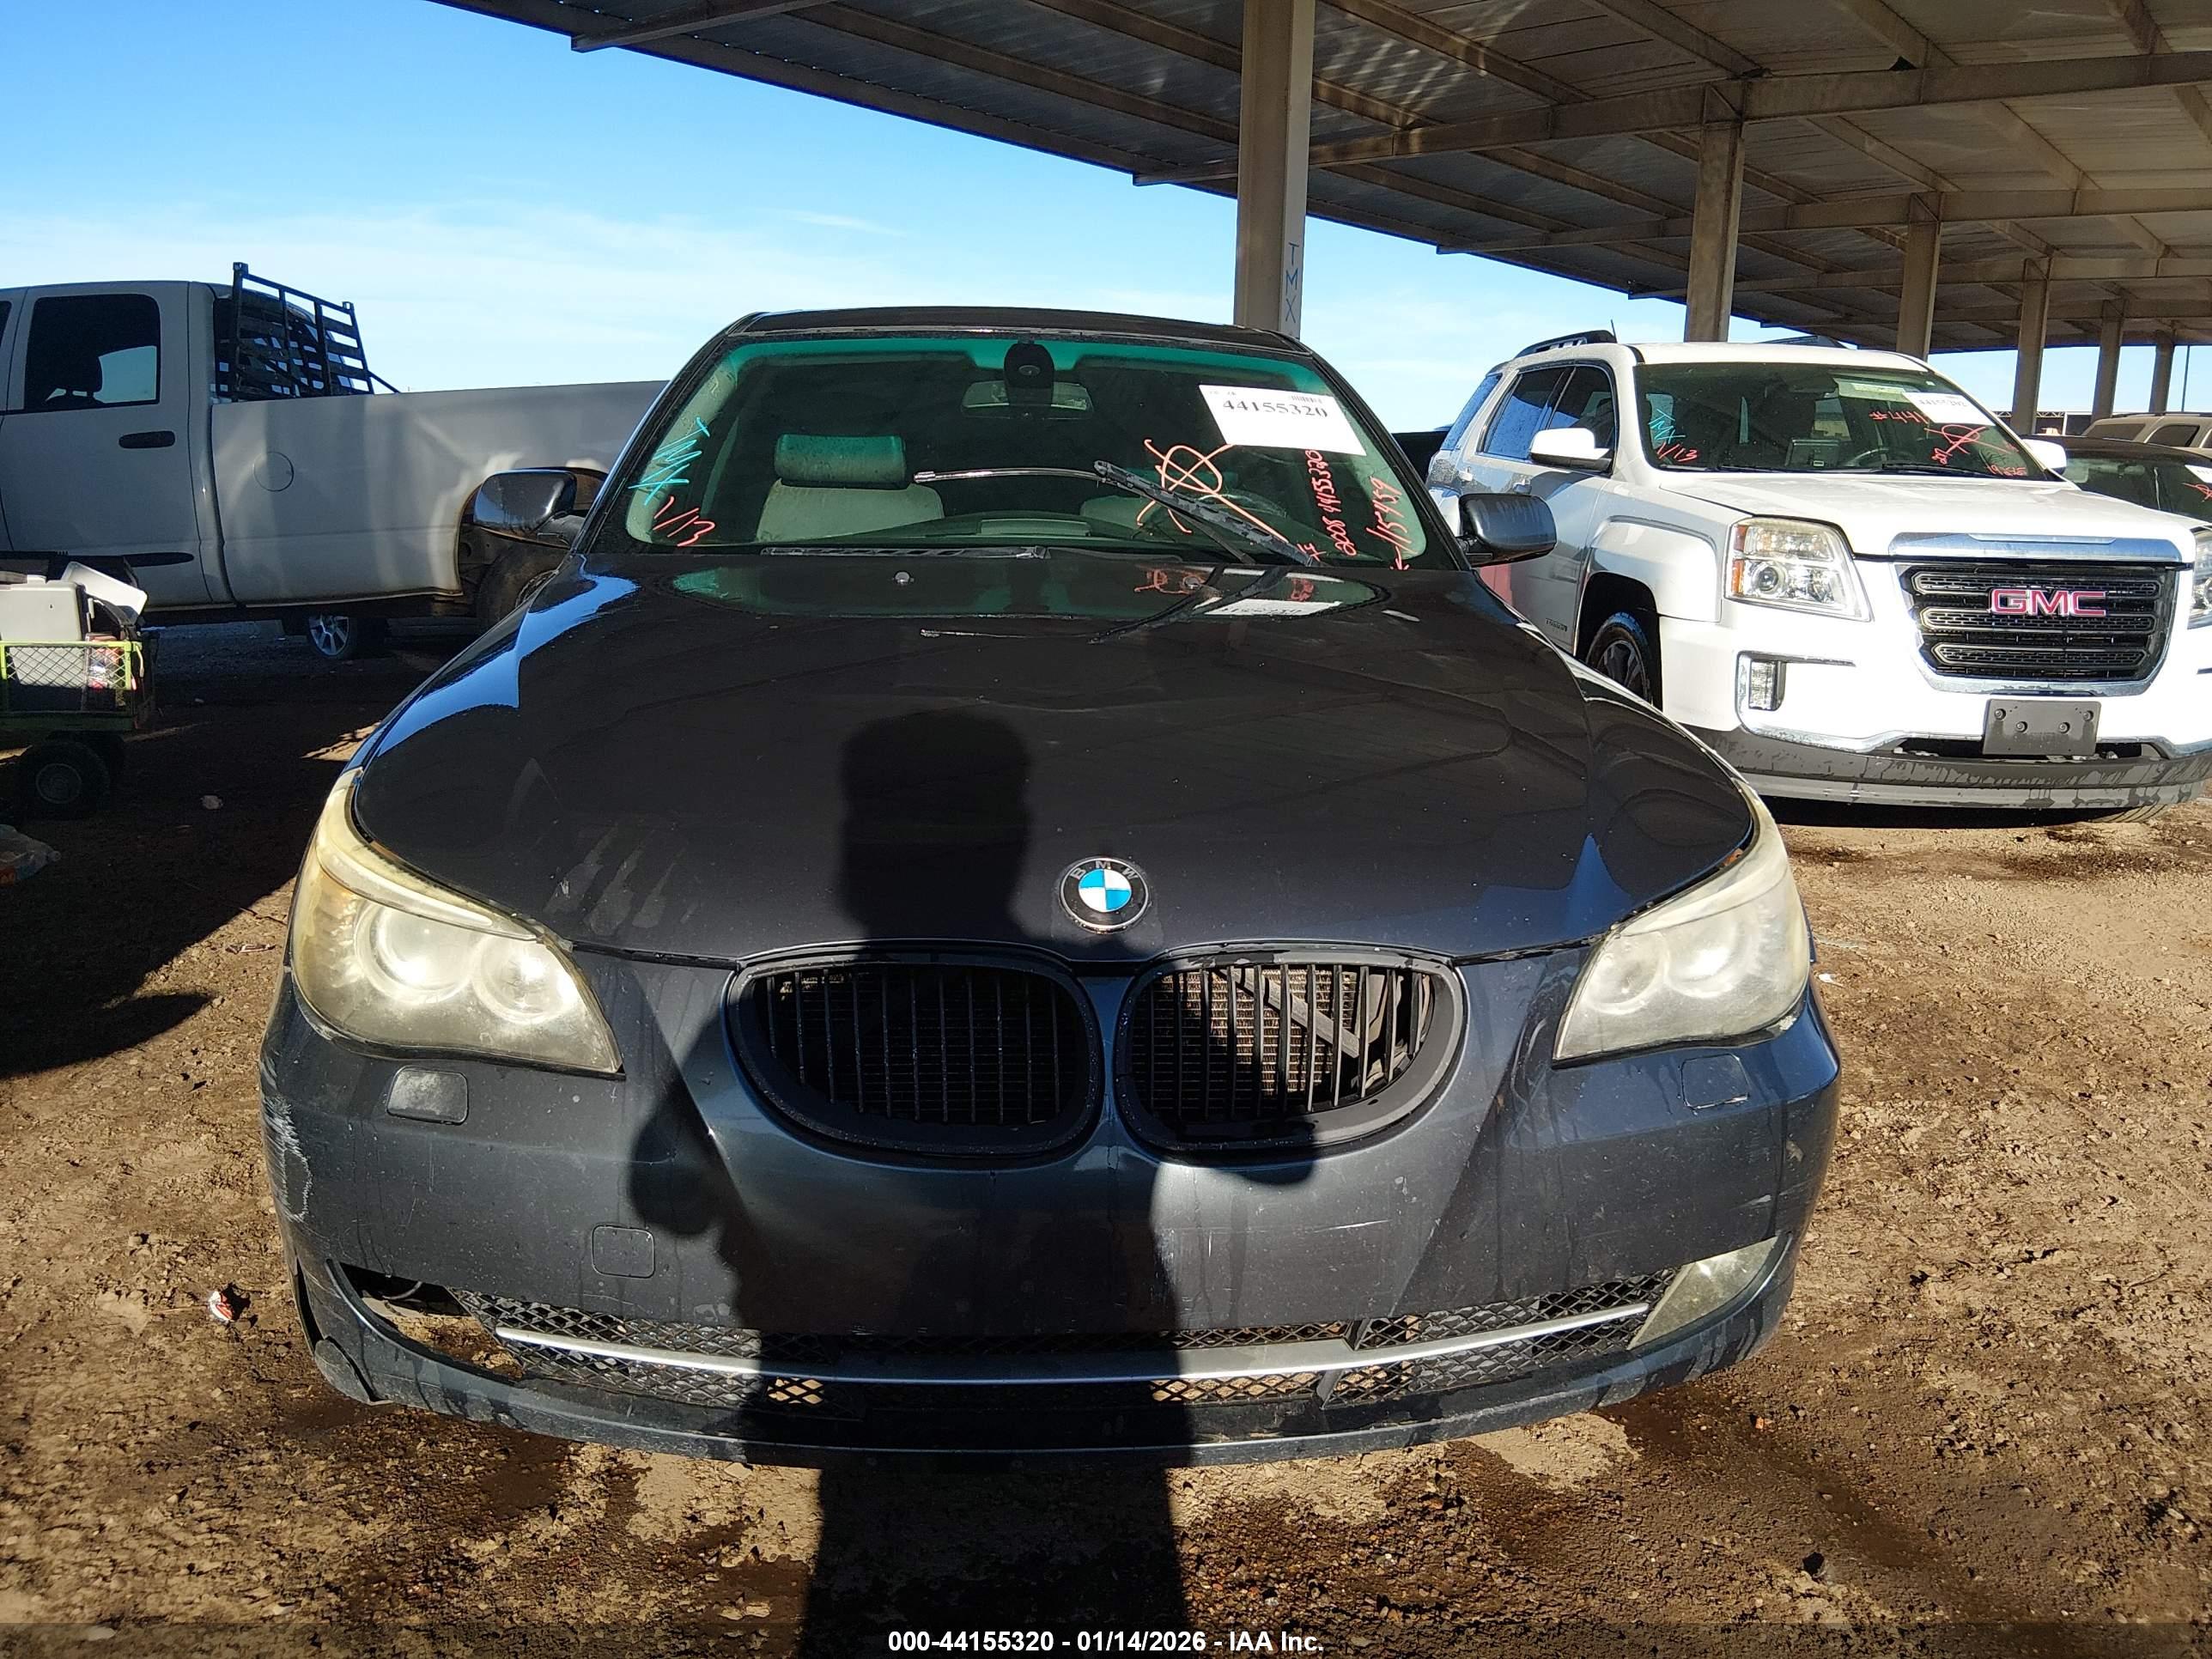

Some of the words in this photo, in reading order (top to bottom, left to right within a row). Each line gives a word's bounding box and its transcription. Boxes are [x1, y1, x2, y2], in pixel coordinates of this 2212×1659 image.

[1285, 242, 1300, 324] TMX
[1223, 398, 1329, 418] 44155320
[1989, 587, 2108, 617] GMC
[1070, 860, 1139, 880] BMW
